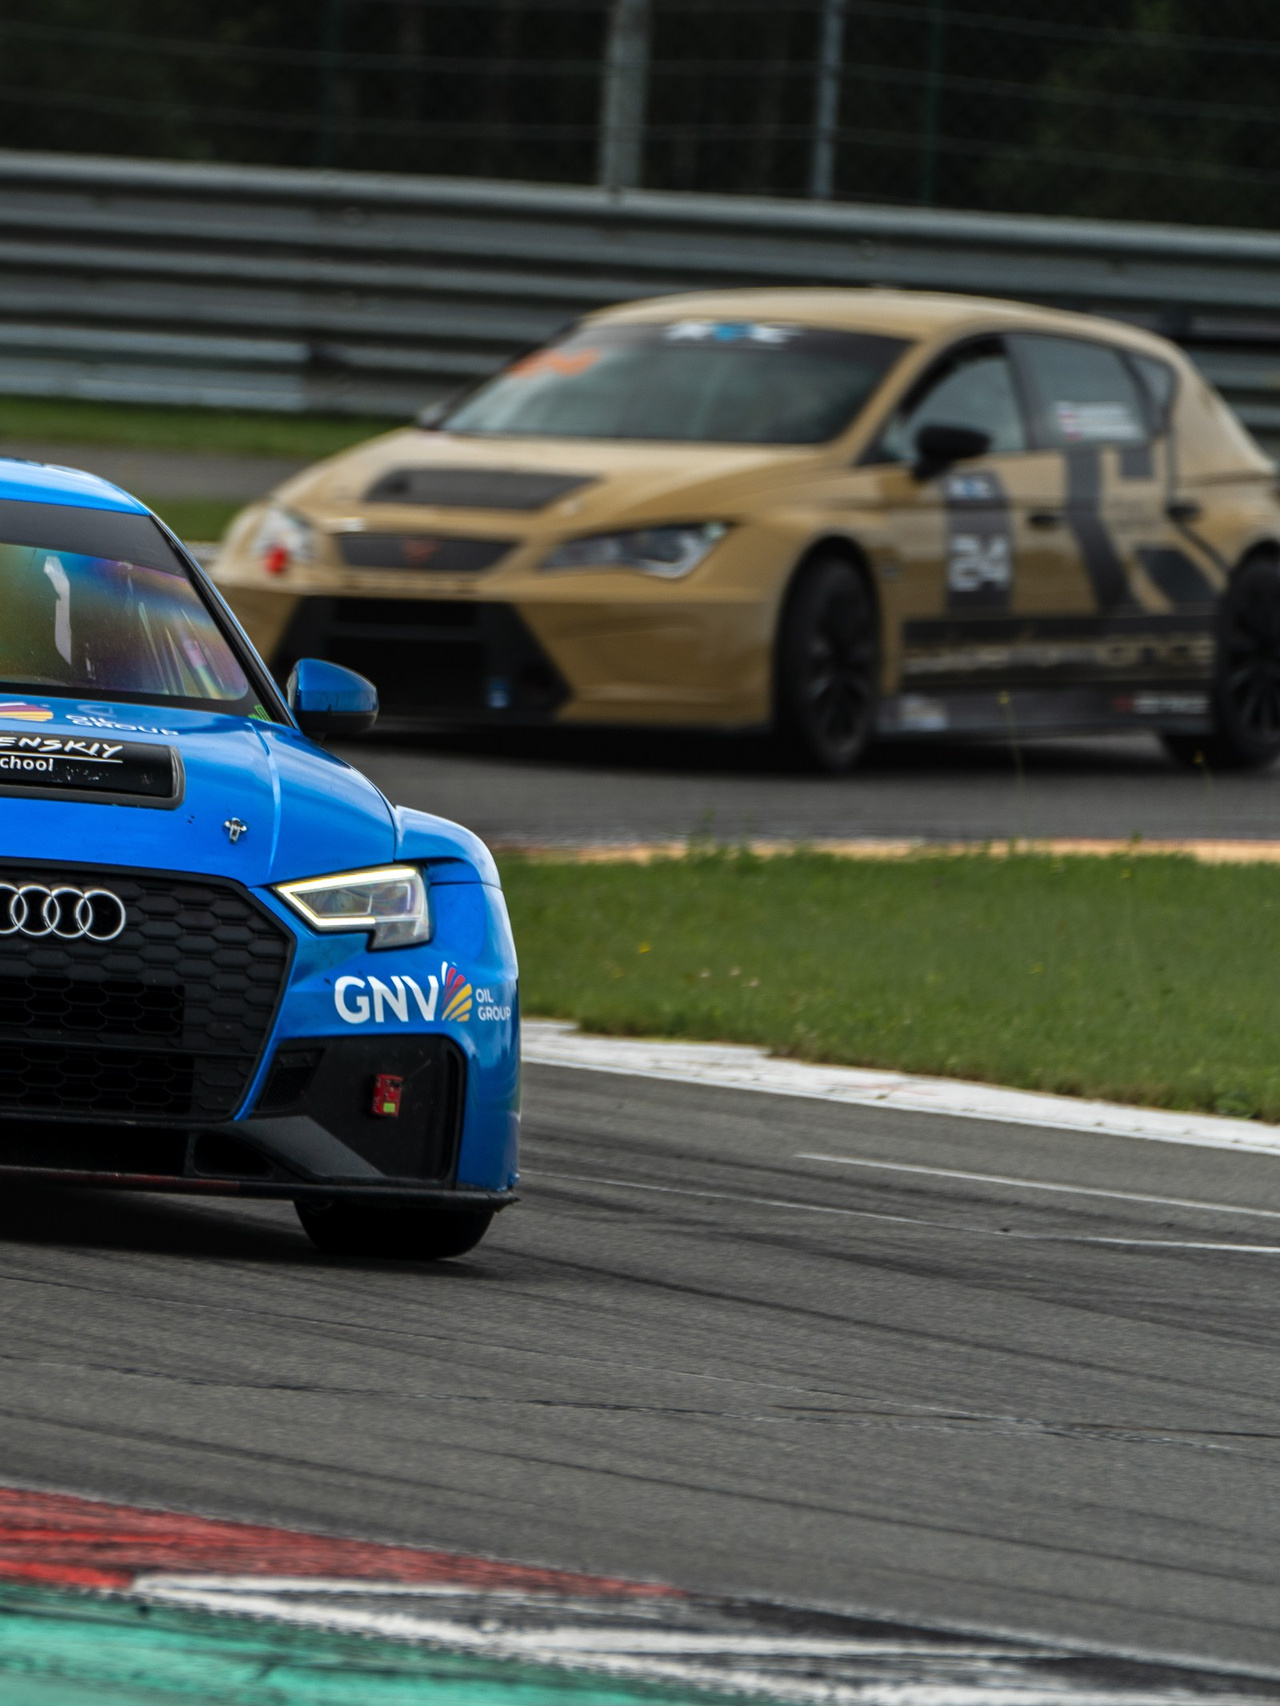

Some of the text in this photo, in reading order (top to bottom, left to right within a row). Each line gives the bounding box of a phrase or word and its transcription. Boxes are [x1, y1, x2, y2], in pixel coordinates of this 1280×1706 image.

[334, 975, 439, 1024] GNV
[475, 988, 494, 1004] OIL
[478, 1006, 512, 1022] GROUP
